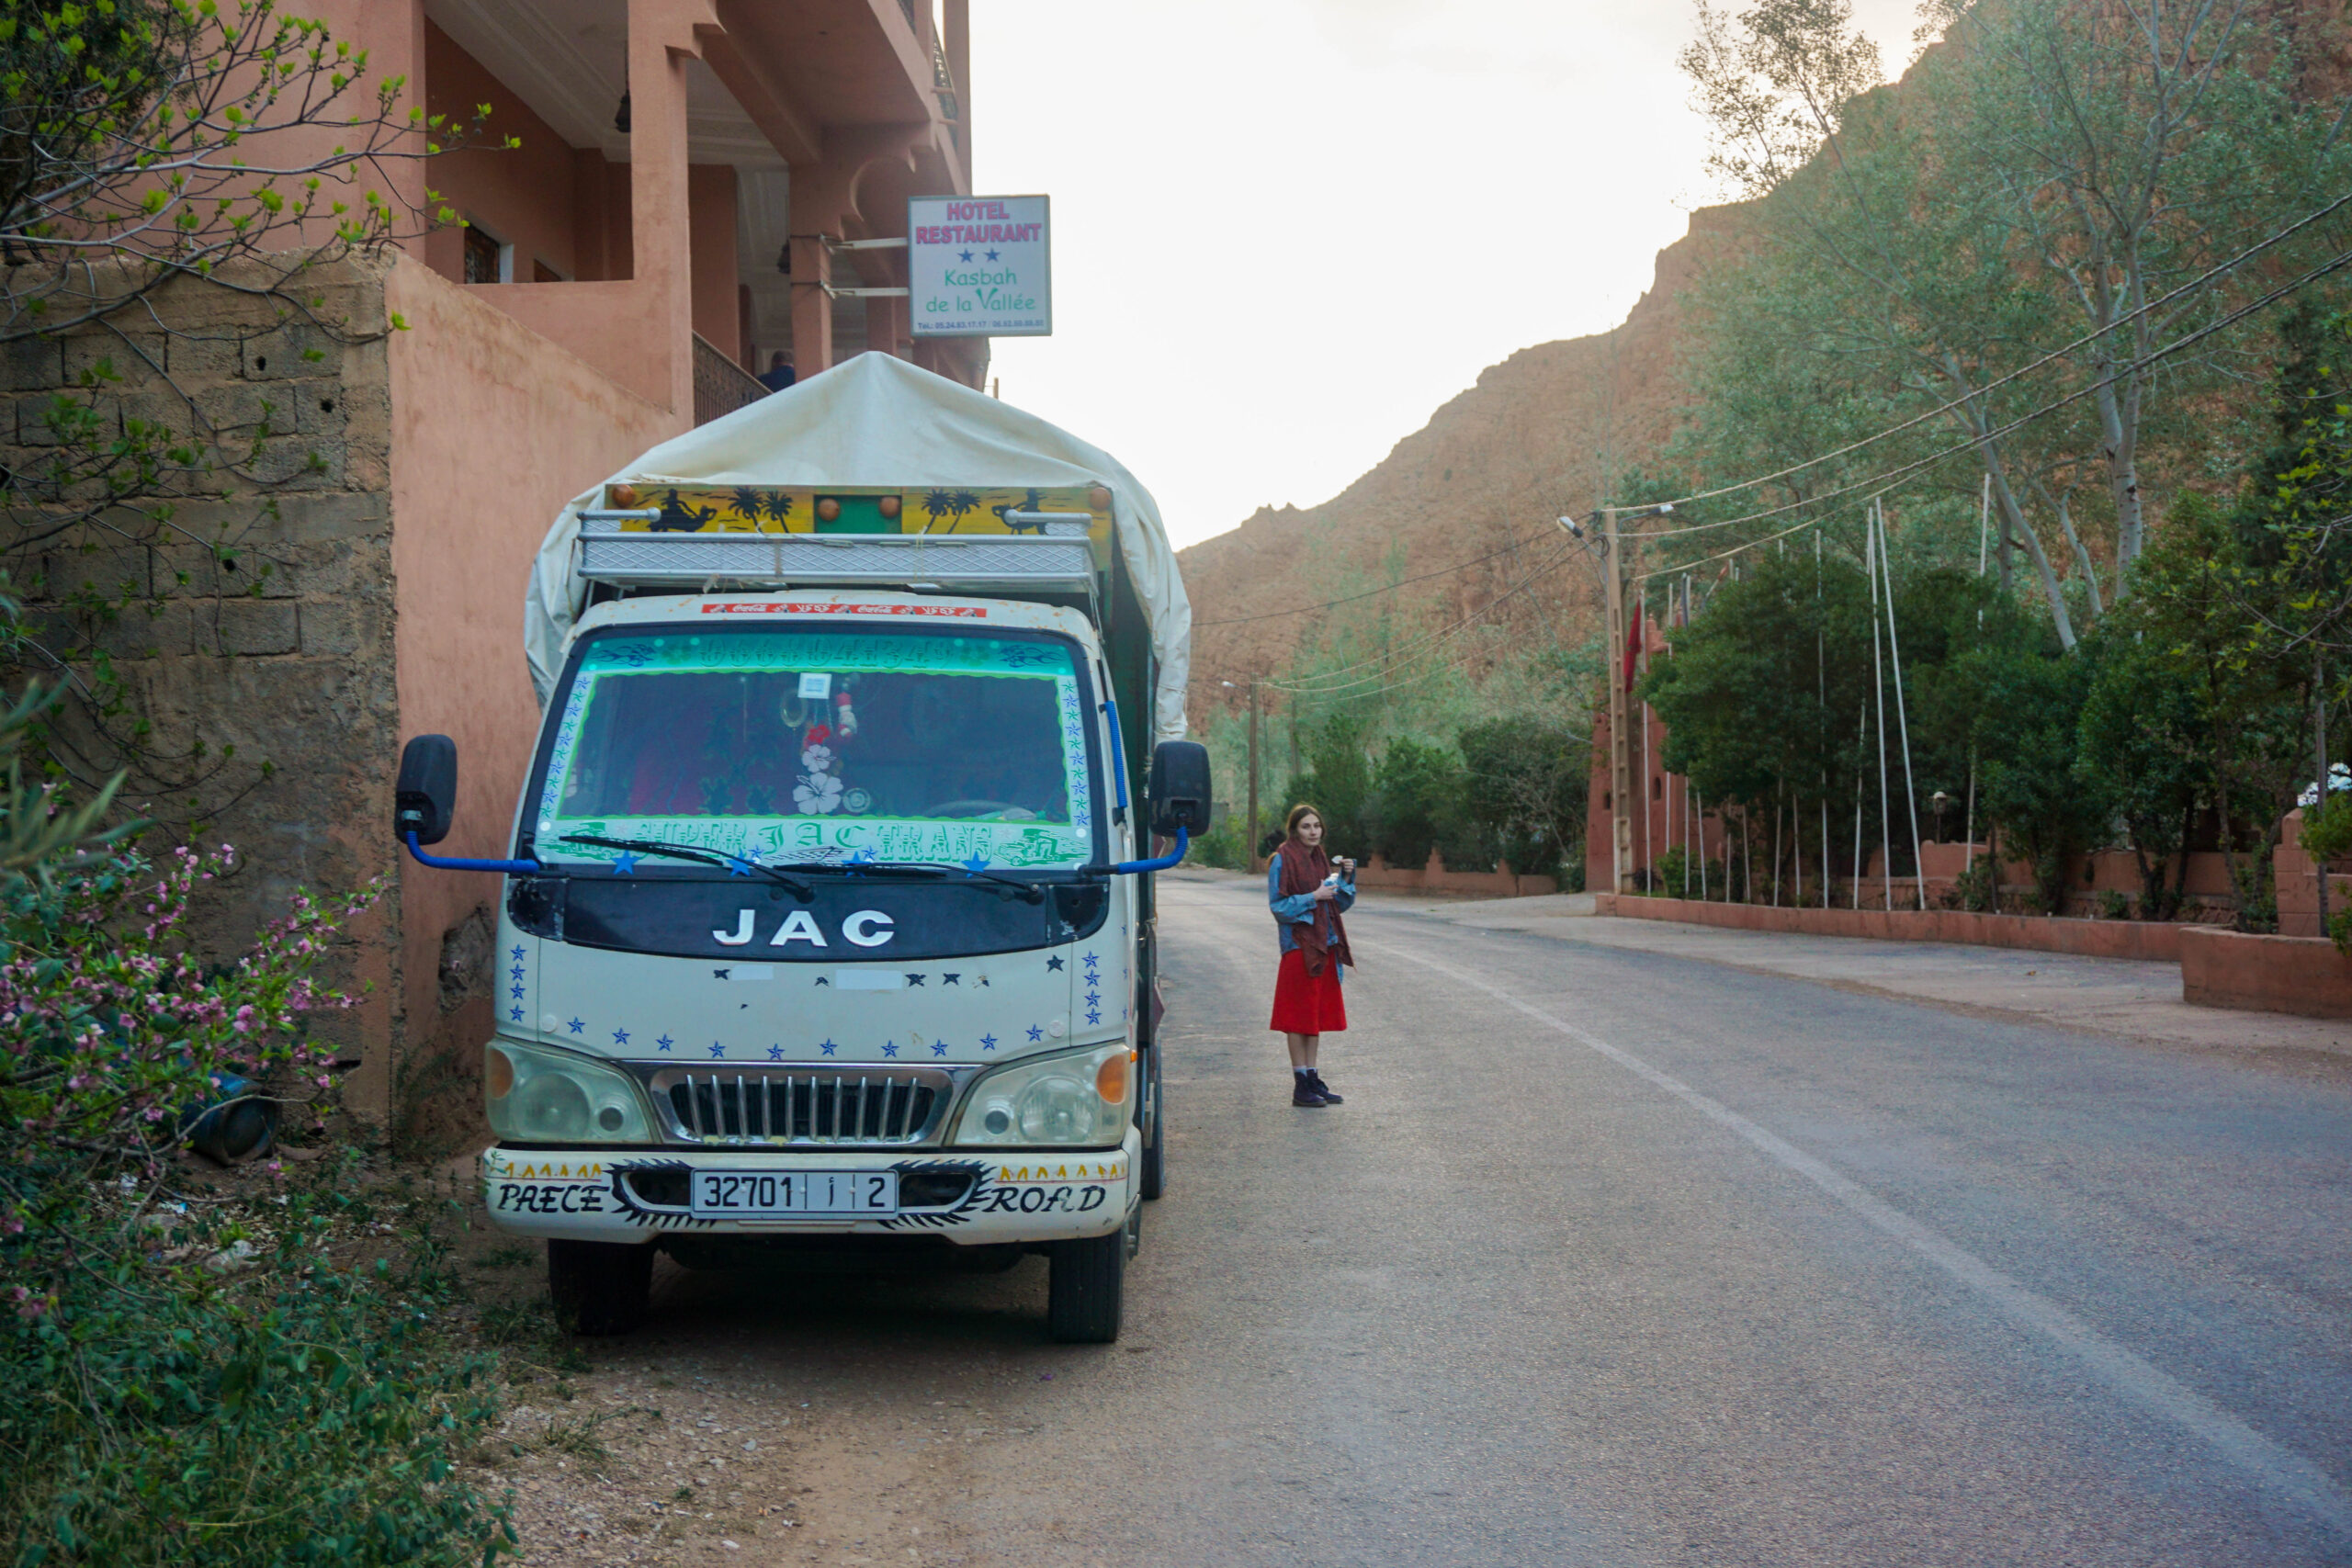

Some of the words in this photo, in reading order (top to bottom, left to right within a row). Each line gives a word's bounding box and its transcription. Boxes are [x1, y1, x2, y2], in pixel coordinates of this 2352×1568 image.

[946, 201, 1010, 220] HOTEL
[916, 223, 1042, 244] RESTAURANT
[944, 267, 1017, 287] Kasbah
[925, 296, 949, 312] de
[956, 296, 972, 311] la
[976, 288, 1036, 310] Vallée
[759, 822, 867, 855] JAC
[712, 908, 895, 947] JAC
[497, 1183, 610, 1213] PAECE
[704, 1176, 791, 1207] 32701
[868, 1177, 886, 1208] 2
[982, 1185, 1106, 1213] ROAD
